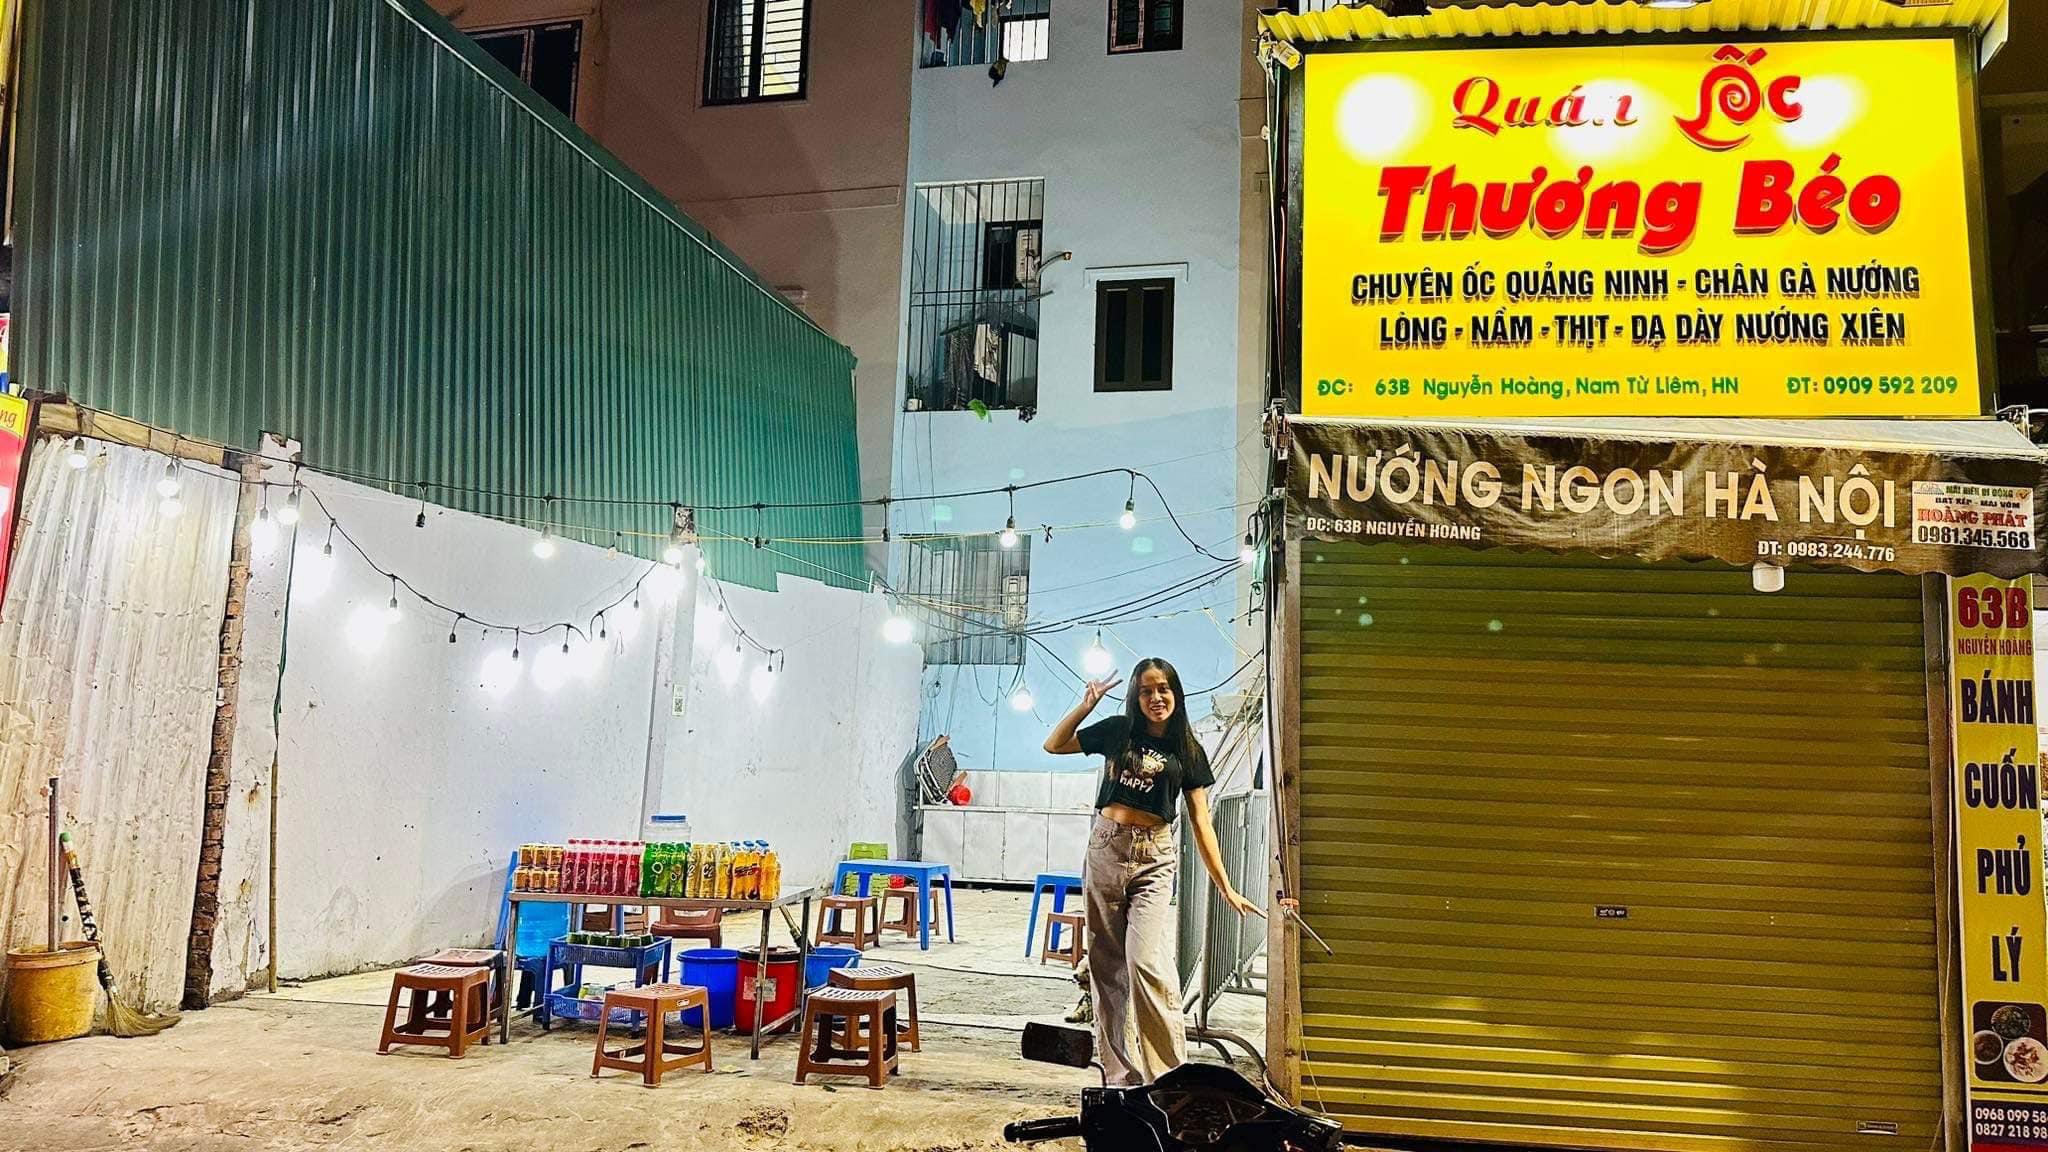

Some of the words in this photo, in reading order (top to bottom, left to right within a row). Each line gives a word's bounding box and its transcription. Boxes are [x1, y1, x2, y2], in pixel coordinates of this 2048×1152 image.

[1378, 165, 1702, 256] Thương
[1733, 152, 1902, 237] Béo
[1352, 267, 1453, 300] CHUYÊN
[1463, 261, 1496, 299] ỐC
[1506, 261, 1594, 300] QUẢNG
[1604, 269, 1669, 298] NINH
[1695, 262, 1769, 297] CHÂN
[1780, 261, 1817, 297] GÀ
[1827, 259, 1920, 297] NƯỚNG
[1380, 311, 1448, 347] LÒNG
[1471, 307, 1533, 346] NẦM
[1554, 314, 1611, 350] THỊT
[1631, 314, 1667, 349] DẠ
[1676, 307, 1724, 344] DÀY
[1736, 305, 1829, 344] NƯỚNG
[1841, 306, 1906, 344] XIÊN
[1317, 379, 1354, 396] ĐC:
[1375, 378, 1410, 396] 63B
[1423, 374, 1493, 400] Nguyễn
[1576, 377, 1620, 395] Nam
[1626, 375, 1649, 395] Từ
[1711, 376, 1739, 395] HN
[1787, 376, 1819, 395] ĐT:
[1823, 376, 1873, 395] 0909
[1878, 376, 1915, 394] 592
[1921, 375, 1958, 394] 209
[1308, 442, 1503, 509] NƯỚNG
[1521, 463, 1684, 516] NGON
[1705, 457, 1779, 522] HÀ
[1799, 463, 1896, 540] NỘI
[1306, 517, 1331, 532] ĐC:
[1334, 518, 1362, 535] 63B
[1366, 516, 1426, 538] NGUYỄN
[1430, 522, 1482, 541] HOÀNG
[1917, 505, 1979, 525] HOÀNG
[1757, 541, 1783, 556] ĐT:
[1787, 541, 1896, 563] 0983.244.776
[1918, 525, 2030, 549] 0981.345.568
[1957, 586, 2030, 629] 63B
[1999, 636, 2033, 657] HOÀNG
[1960, 669, 2035, 725] BÁNH
[1963, 747, 2038, 810] CUỐN
[1976, 834, 2032, 896] PHỦ
[1991, 926, 2024, 983] LÝ
[1975, 1107, 2005, 1121] 0968
[2007, 1109, 2030, 1123] 099
[2032, 1110, 2048, 1124] 58
[1975, 1122, 2005, 1137] 0827
[2007, 1124, 2031, 1138] 218
